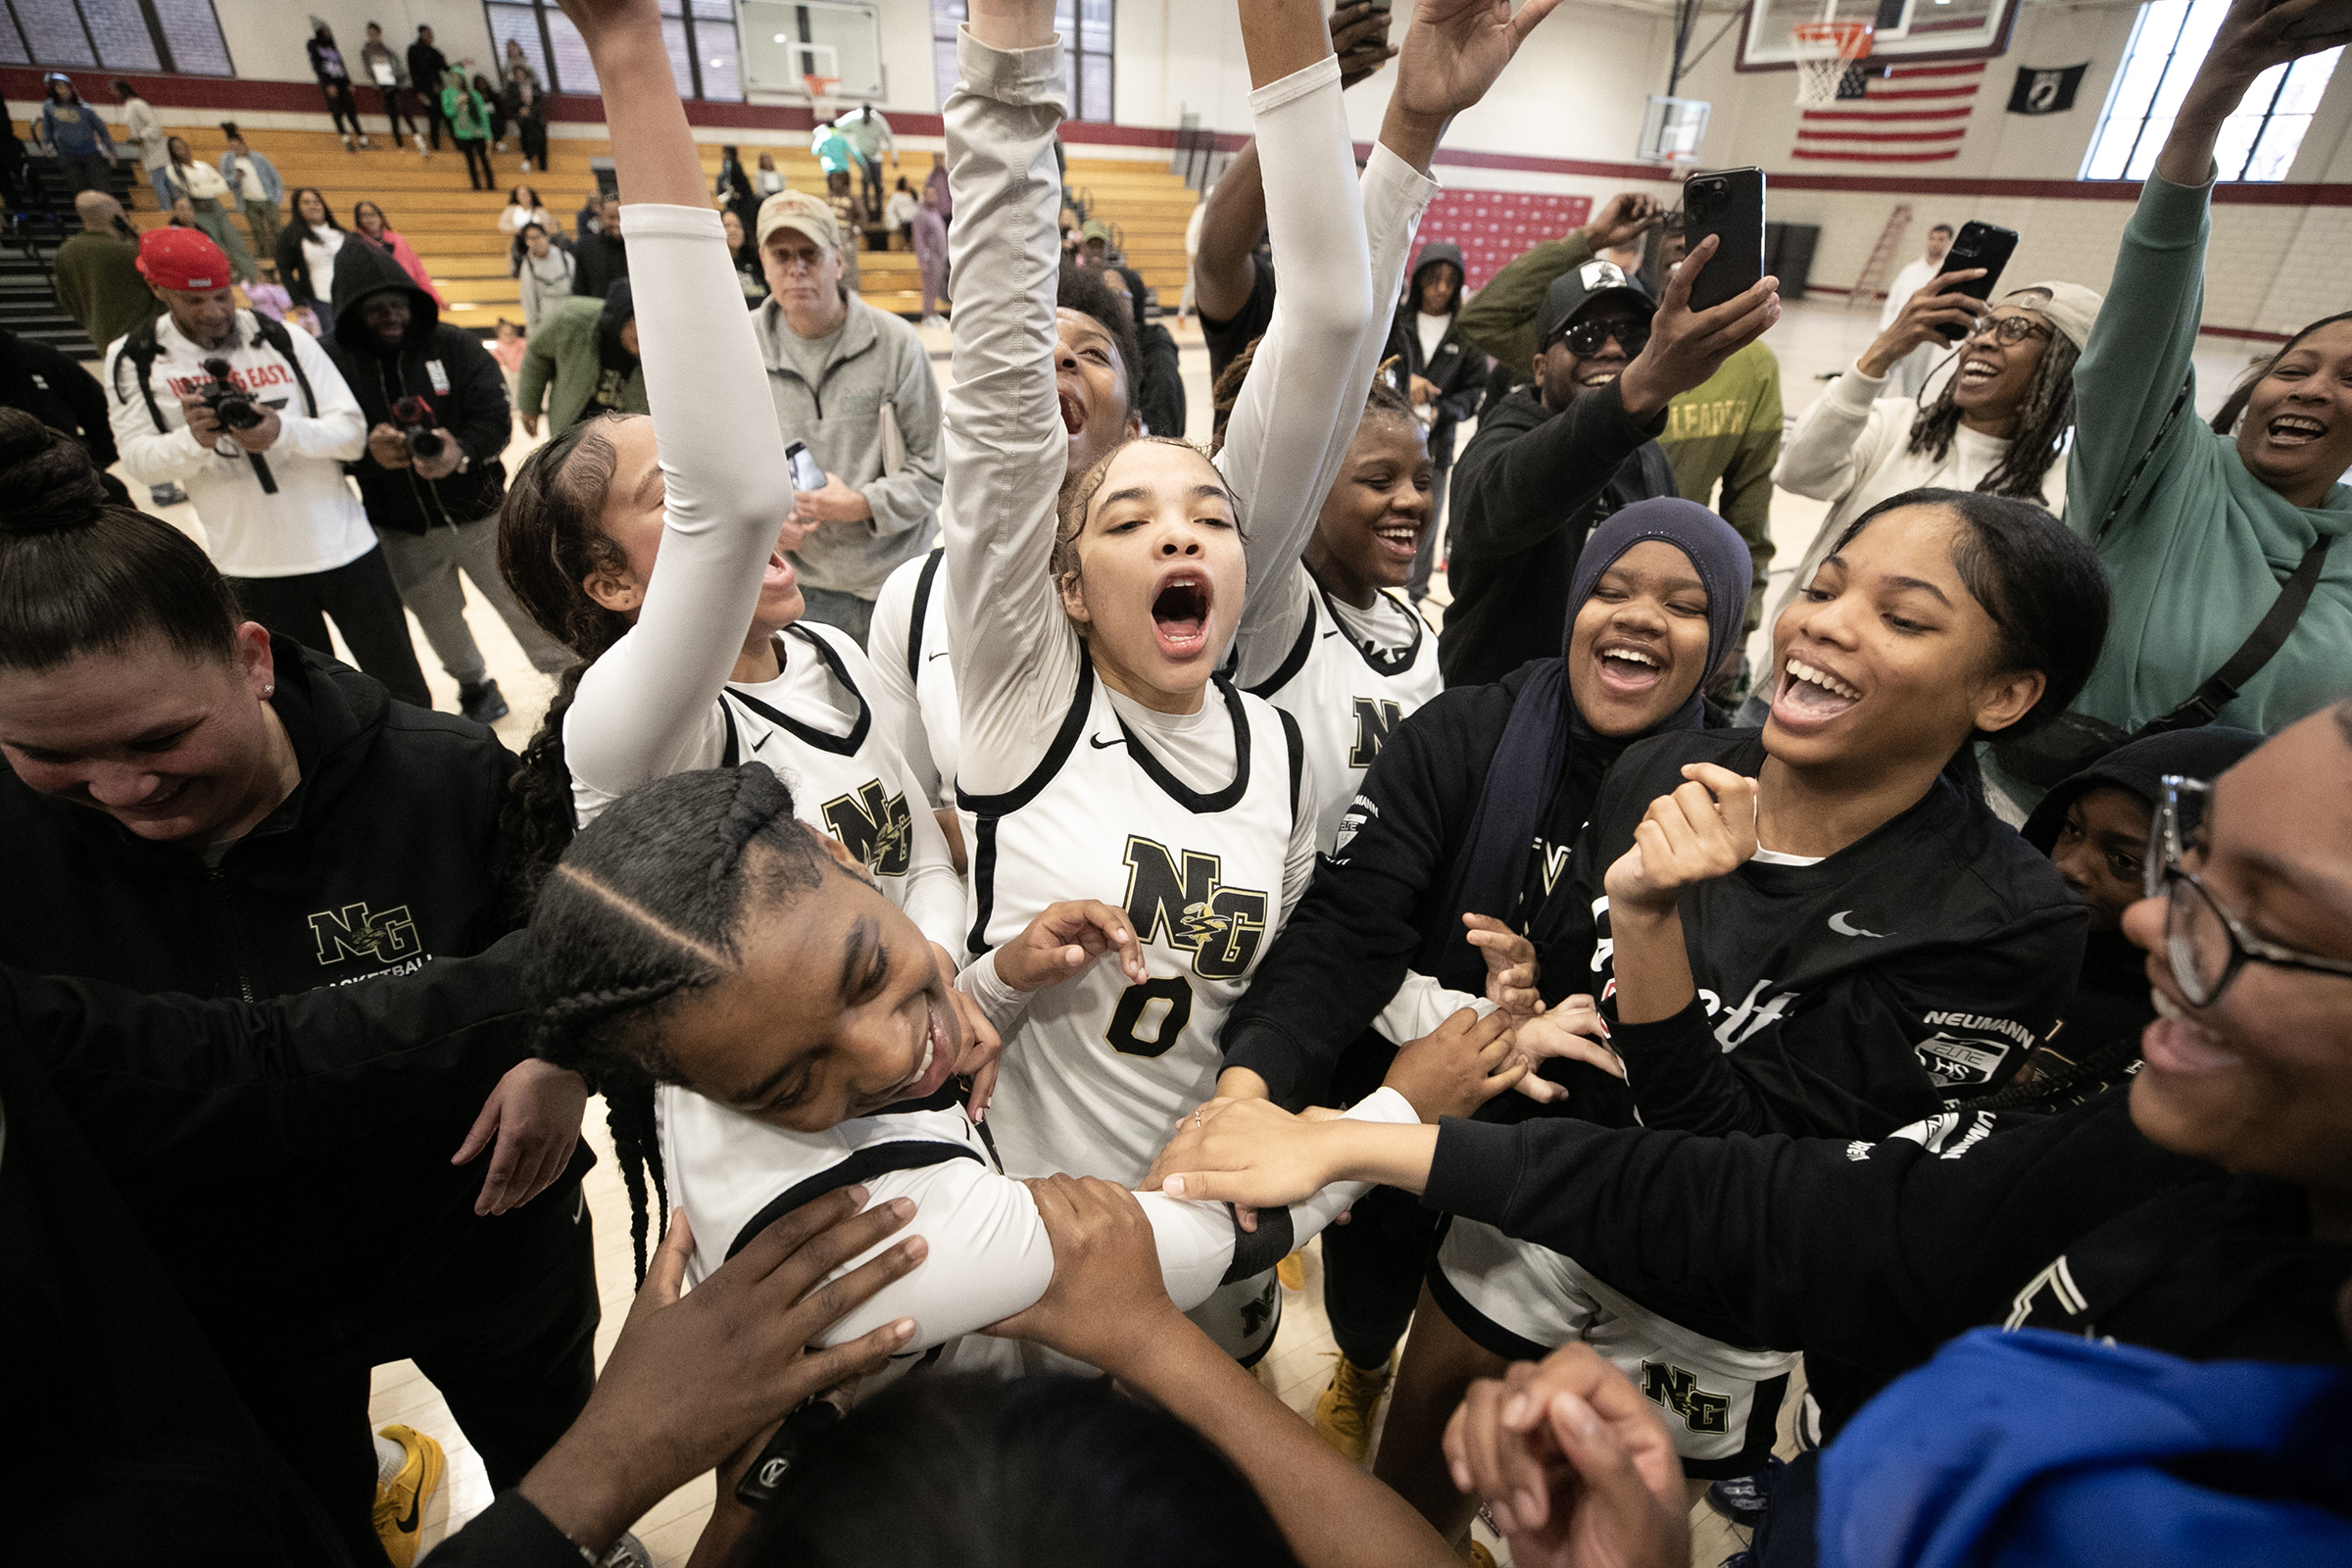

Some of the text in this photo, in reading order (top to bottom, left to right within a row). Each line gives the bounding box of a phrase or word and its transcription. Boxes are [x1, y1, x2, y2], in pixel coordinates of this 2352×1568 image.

[167, 370, 248, 399] NOTHG
[247, 365, 293, 388] EASY.
[820, 777, 912, 877] NG
[1351, 795, 1379, 818] MANN
[308, 902, 421, 965] NG
[1122, 834, 1268, 980] NG
[1102, 976, 1193, 1059] 0
[1923, 1010, 2035, 1050] NEUMANN
[1933, 1043, 1987, 1066] ELITE
[1642, 1358, 1731, 1435] NG
